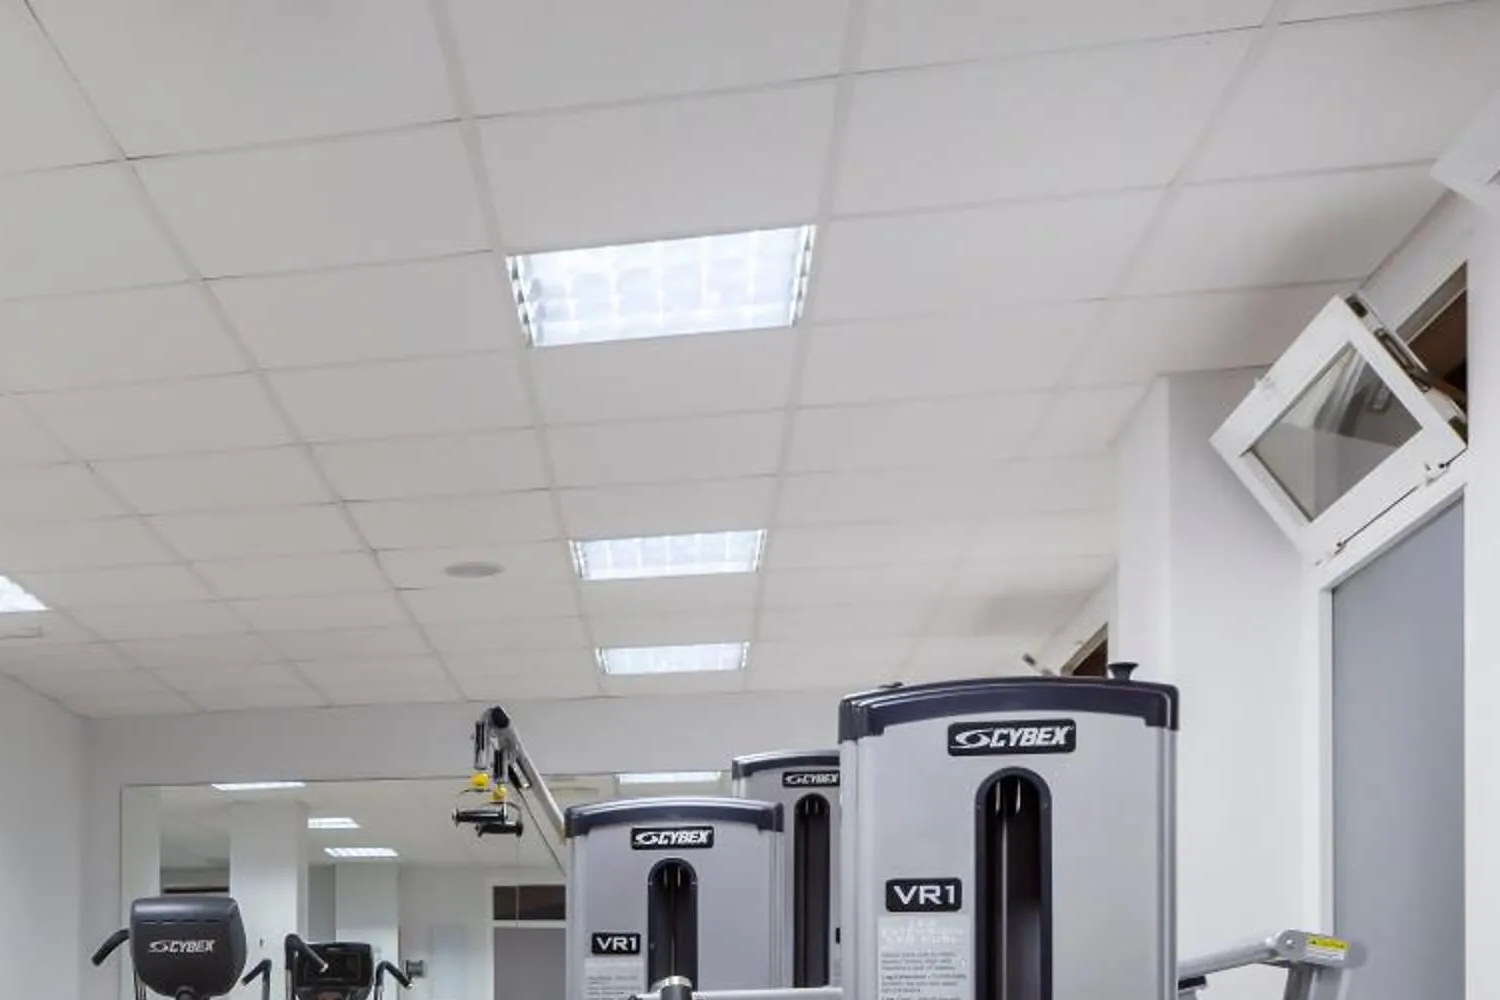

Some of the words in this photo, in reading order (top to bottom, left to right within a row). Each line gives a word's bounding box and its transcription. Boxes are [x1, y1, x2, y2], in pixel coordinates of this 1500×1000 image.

[988, 725, 1071, 748] CYBEX
[657, 829, 710, 845] CYBEX
[893, 885, 956, 905] VR1
[169, 939, 216, 953] CYBEX
[596, 936, 638, 951] VR1
